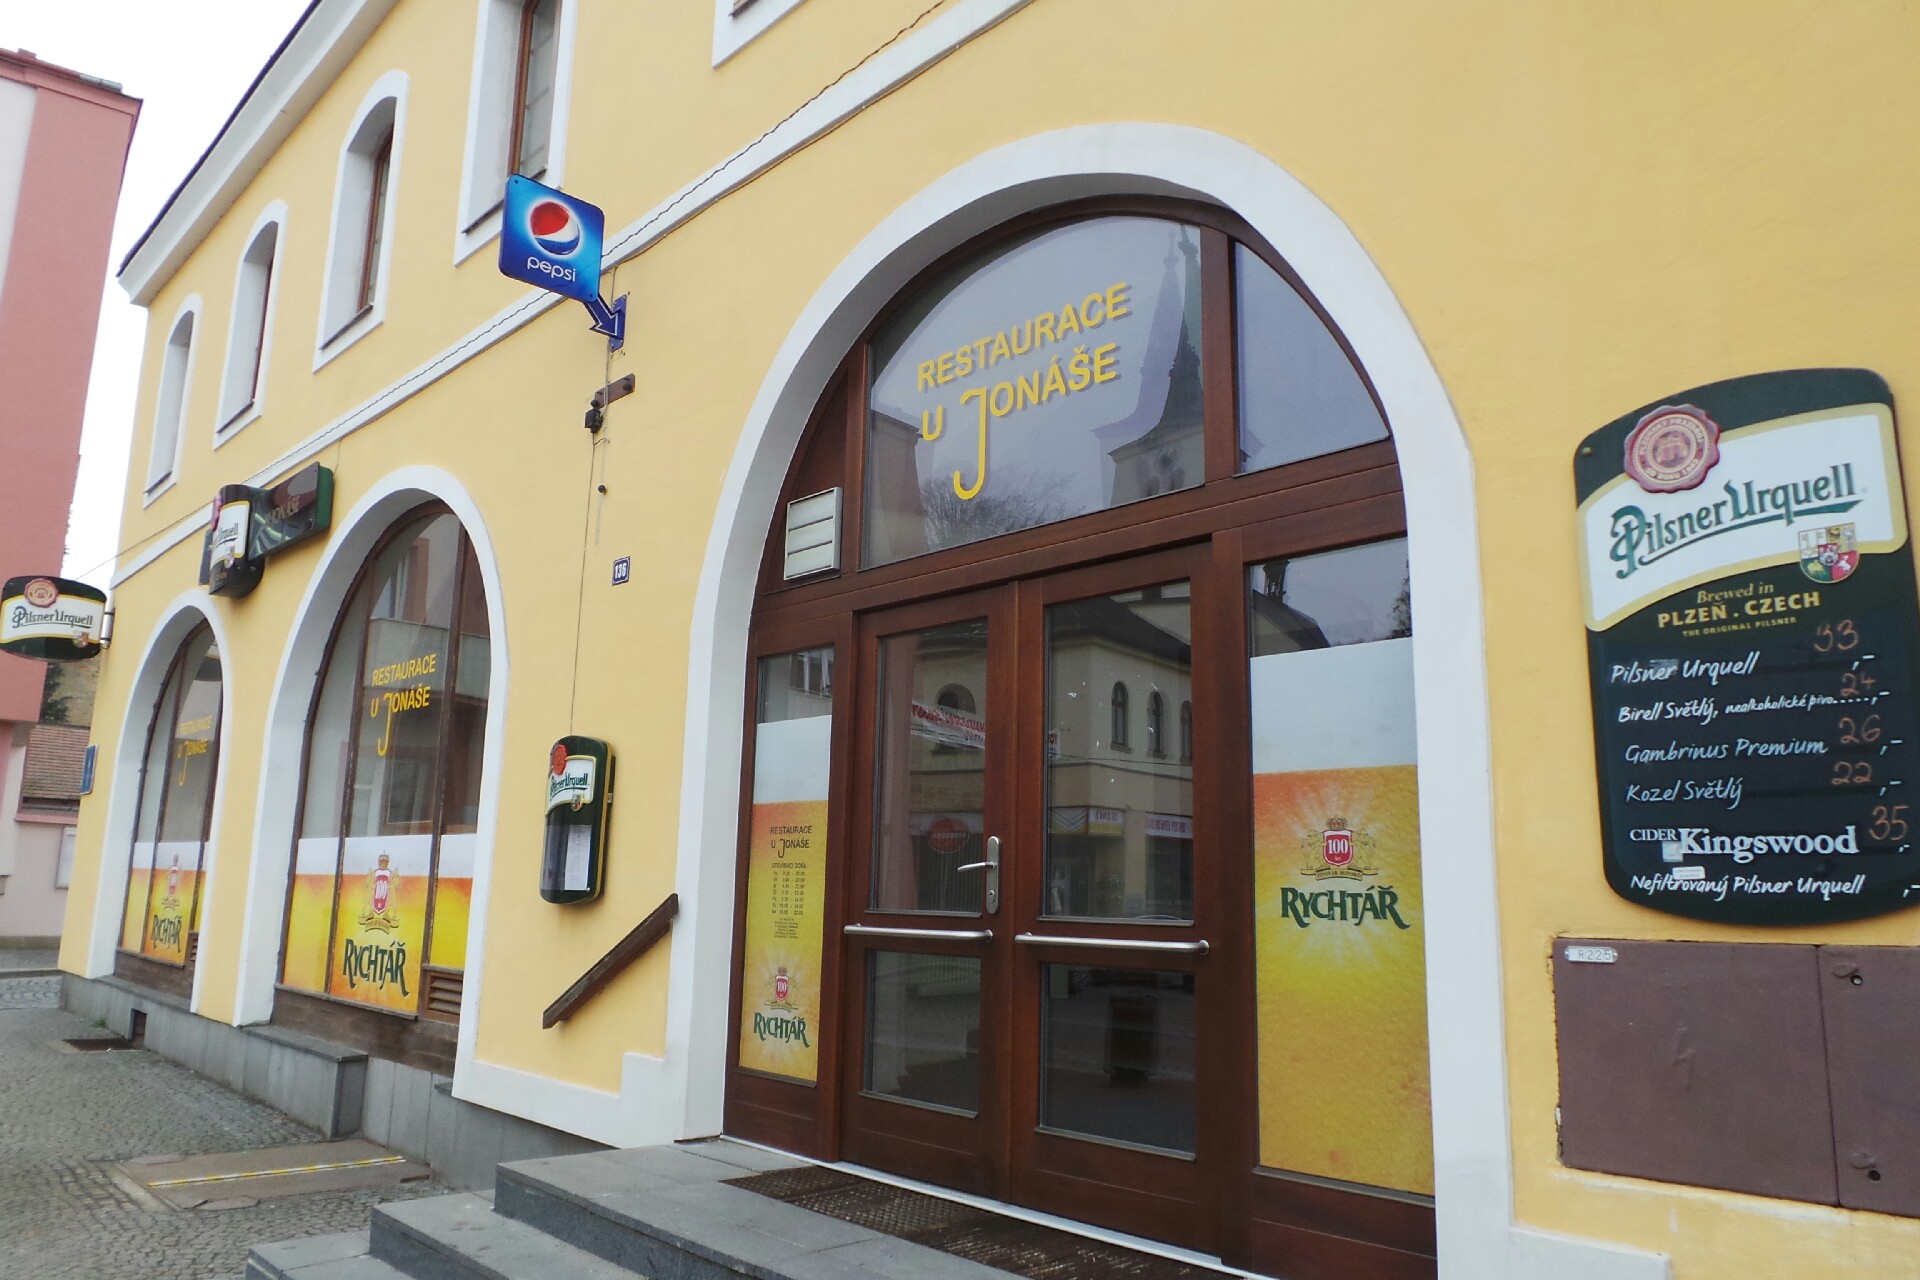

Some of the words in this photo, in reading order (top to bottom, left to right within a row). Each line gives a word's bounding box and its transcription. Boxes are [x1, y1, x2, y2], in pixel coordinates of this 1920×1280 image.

[527, 256, 576, 282] pepsi
[917, 281, 1128, 392] RESTAURACE
[922, 404, 944, 441] U
[953, 342, 1118, 500] JONÁŠE
[1609, 500, 1728, 580] Pilsner
[1724, 463, 1856, 527] Urquell
[615, 562, 627, 579] 136
[1657, 602, 1728, 628] PLZEŇ
[1744, 591, 1822, 616] CZECH
[1697, 583, 1754, 604] Brewed
[1759, 582, 1775, 595] in
[12, 605, 54, 629] Pilsner
[55, 609, 93, 628] Urquell
[1682, 629, 1701, 637] THE
[1703, 622, 1751, 635] ORIGINAL
[1755, 616, 1798, 628] PILSNER
[371, 653, 437, 687] RESTAURACE
[1610, 661, 1679, 684] Pilsner
[1683, 651, 1761, 685] Urquell
[370, 697, 380, 718] U
[377, 682, 431, 756] JONÁŠE
[1618, 701, 1662, 723] Birell
[1624, 740, 1729, 764] Gambrinus
[1734, 738, 1829, 758] Premium
[1839, 714, 1881, 743] 26
[1626, 780, 1683, 802] Kozel
[1682, 777, 1744, 810] Světlý
[1831, 761, 1873, 786] 22
[770, 825, 812, 835] RESTAURACE
[771, 840, 776, 849] U
[1327, 838, 1349, 854] 100
[1629, 829, 1679, 842] CIDER
[1676, 824, 1861, 864] Kingswood
[1869, 804, 1910, 841] 35
[375, 880, 389, 899] 100
[1629, 873, 1729, 901] Nefiltrovaný
[1732, 876, 1793, 894] Pilsner
[1797, 874, 1866, 901] Urquell
[1280, 885, 1413, 930] RYCHTÁŘ
[151, 914, 182, 954] RYCHTÁŘ
[342, 938, 410, 997] RYCHTÁŘ
[1578, 949, 1612, 961] R225
[753, 1012, 810, 1048] RYCHTÁŘ
